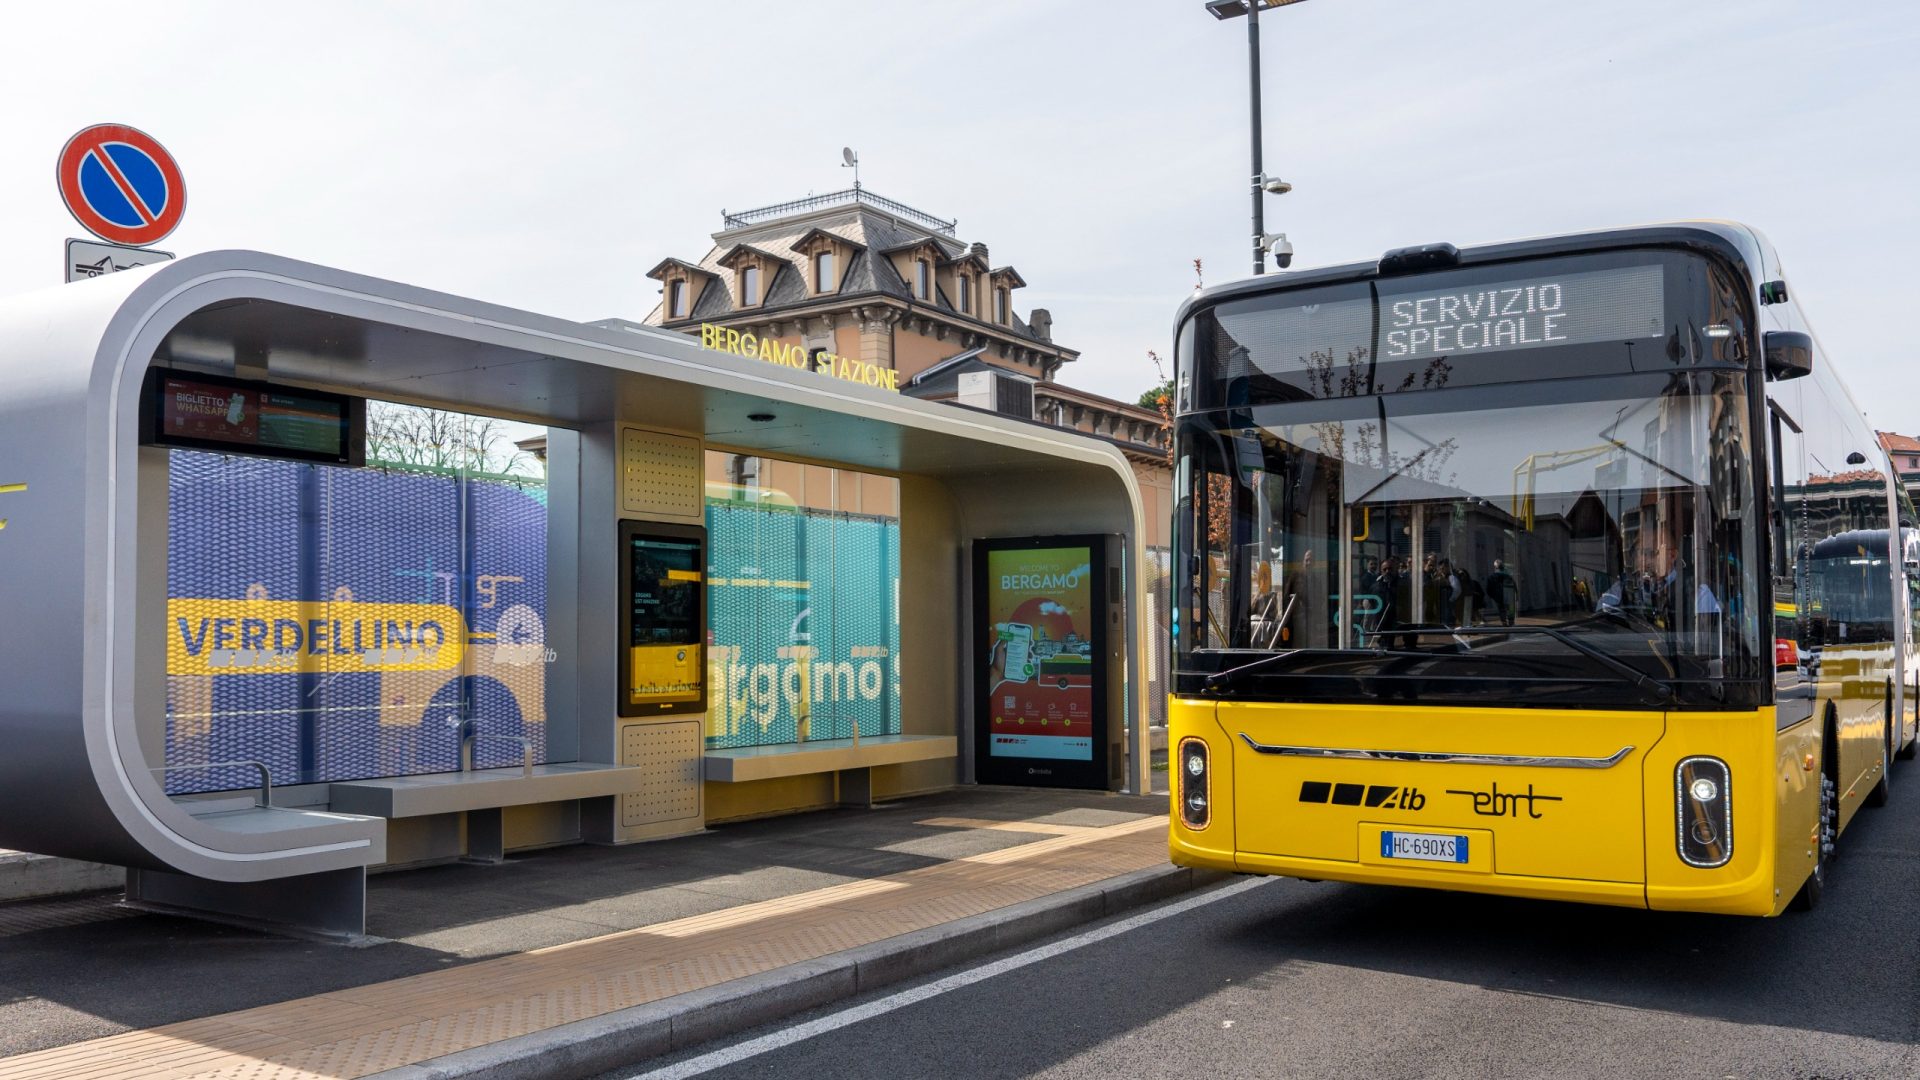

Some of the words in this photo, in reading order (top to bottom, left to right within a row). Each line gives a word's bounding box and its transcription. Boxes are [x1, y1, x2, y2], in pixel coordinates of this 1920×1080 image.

[1393, 283, 1562, 327] SERVIZIO
[1387, 312, 1567, 356] SPECIALE
[701, 322, 808, 370] BERGAMO
[816, 350, 900, 393] STAZIONE
[175, 392, 224, 408] BIGLIETTO
[175, 401, 229, 417] WHATSAPP
[1001, 574, 1079, 590] BERGAMO
[176, 617, 446, 657] VERDELLINO
